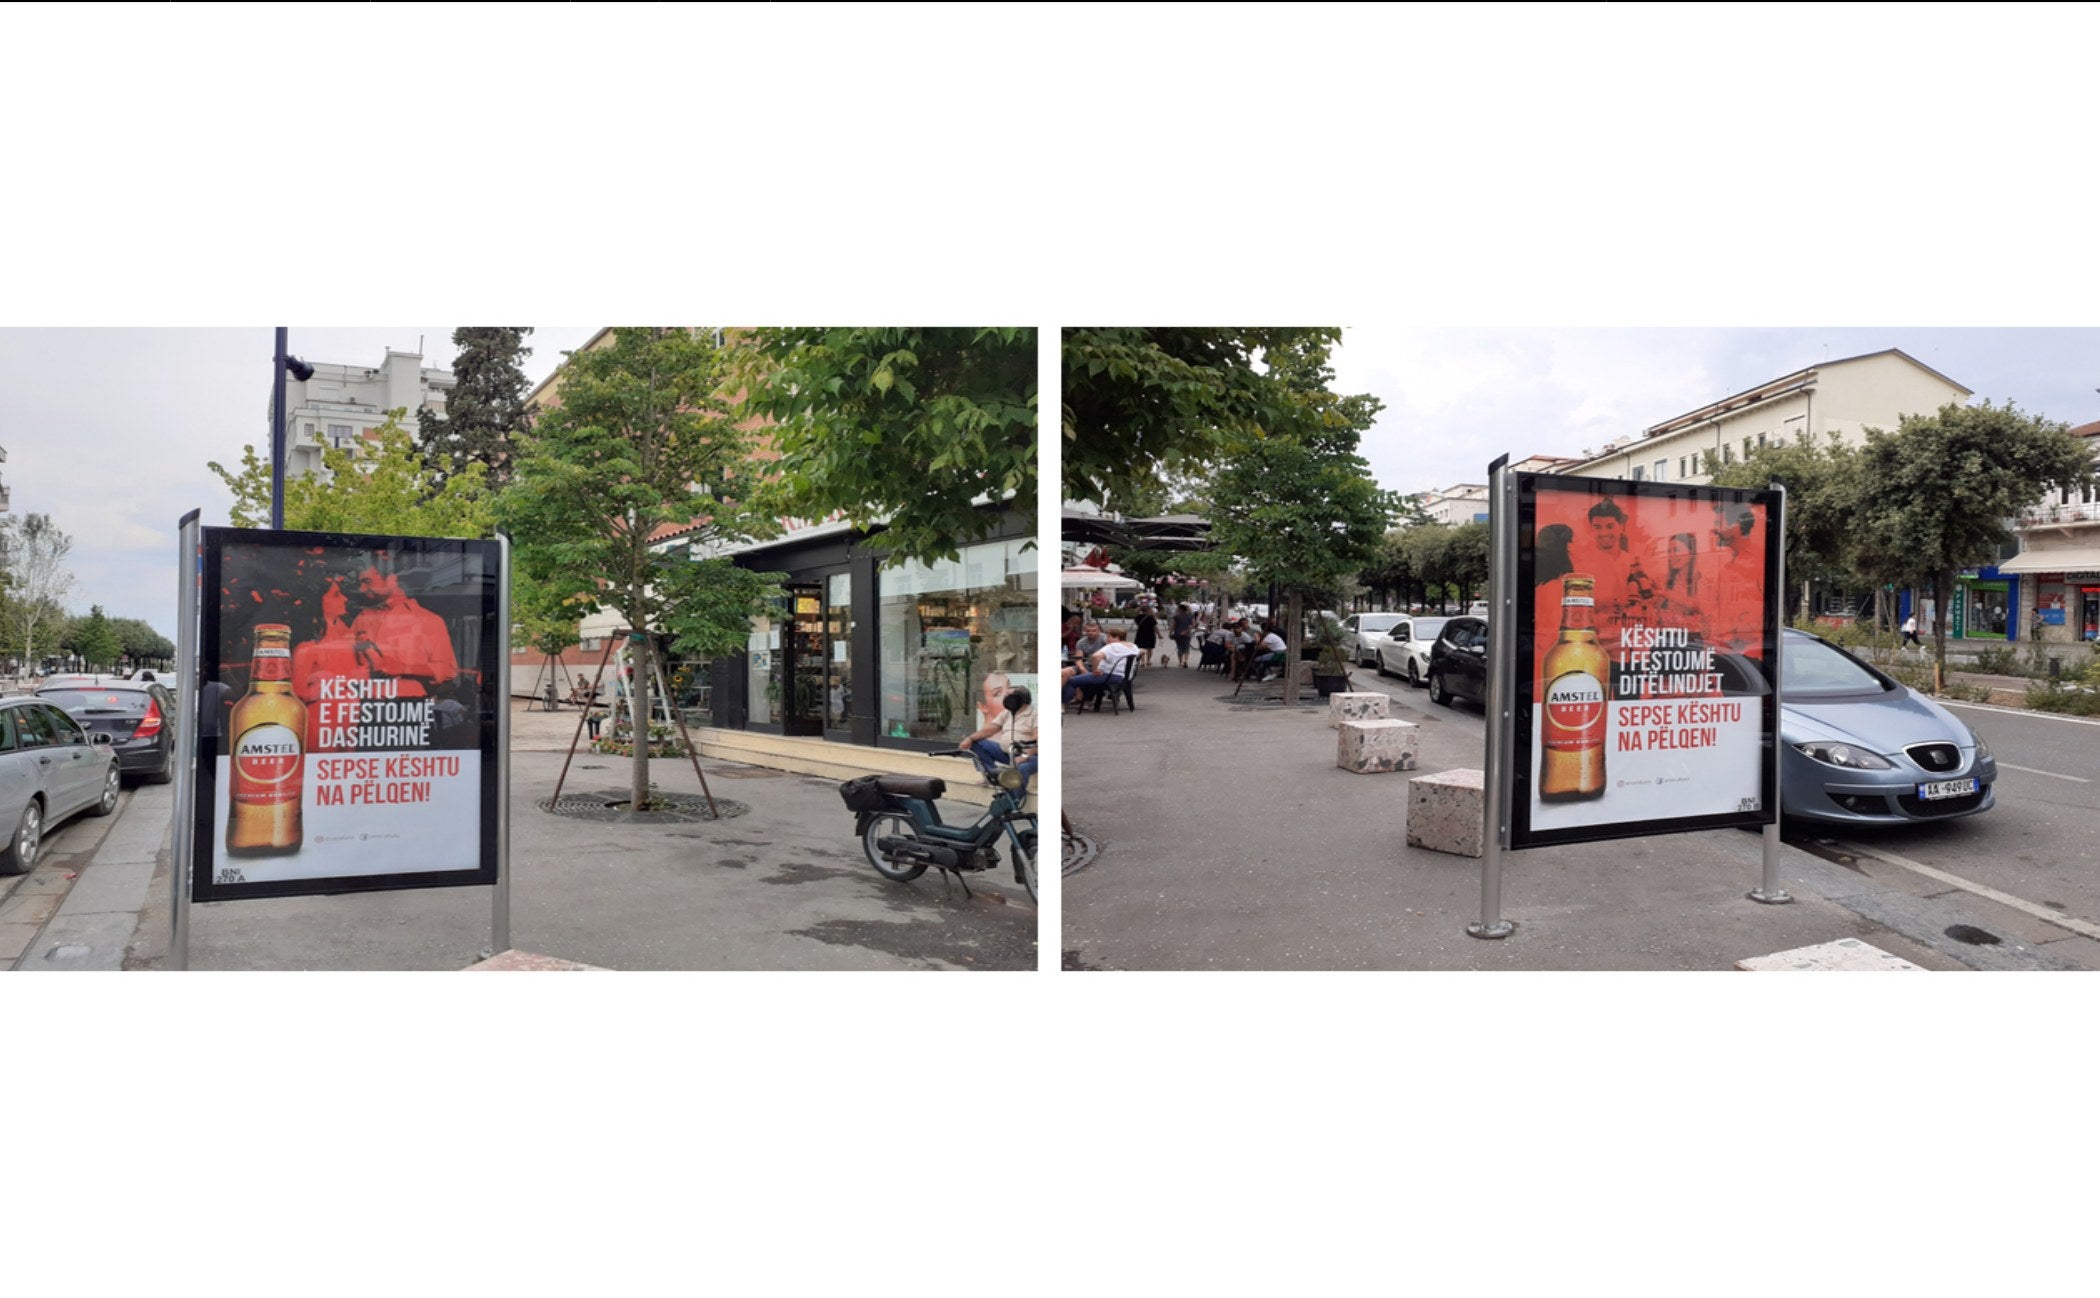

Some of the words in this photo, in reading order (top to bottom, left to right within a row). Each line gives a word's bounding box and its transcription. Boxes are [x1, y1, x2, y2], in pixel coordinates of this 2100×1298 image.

[1621, 624, 1688, 648] KËSHTU
[1620, 651, 1626, 671] I
[1631, 647, 1716, 671] FESTOJMË
[320, 675, 398, 699] KËSHTU
[1620, 670, 1724, 695] DITËLINDJET
[1551, 691, 1599, 702] AMSTEL
[319, 702, 331, 723] E
[337, 698, 435, 723] FESTOJMË
[1618, 705, 1673, 727] SEPSE
[1677, 701, 1741, 724] KËSHTU
[318, 722, 430, 748] DASHURINË
[1618, 731, 1642, 752] NA
[1647, 726, 1717, 750] PËLQEN!
[240, 744, 296, 755] AMSTEL
[316, 757, 380, 780] SEPSE
[385, 754, 460, 778] KËSHTU
[316, 784, 345, 806] NA
[350, 780, 431, 804] PËLQEN!
